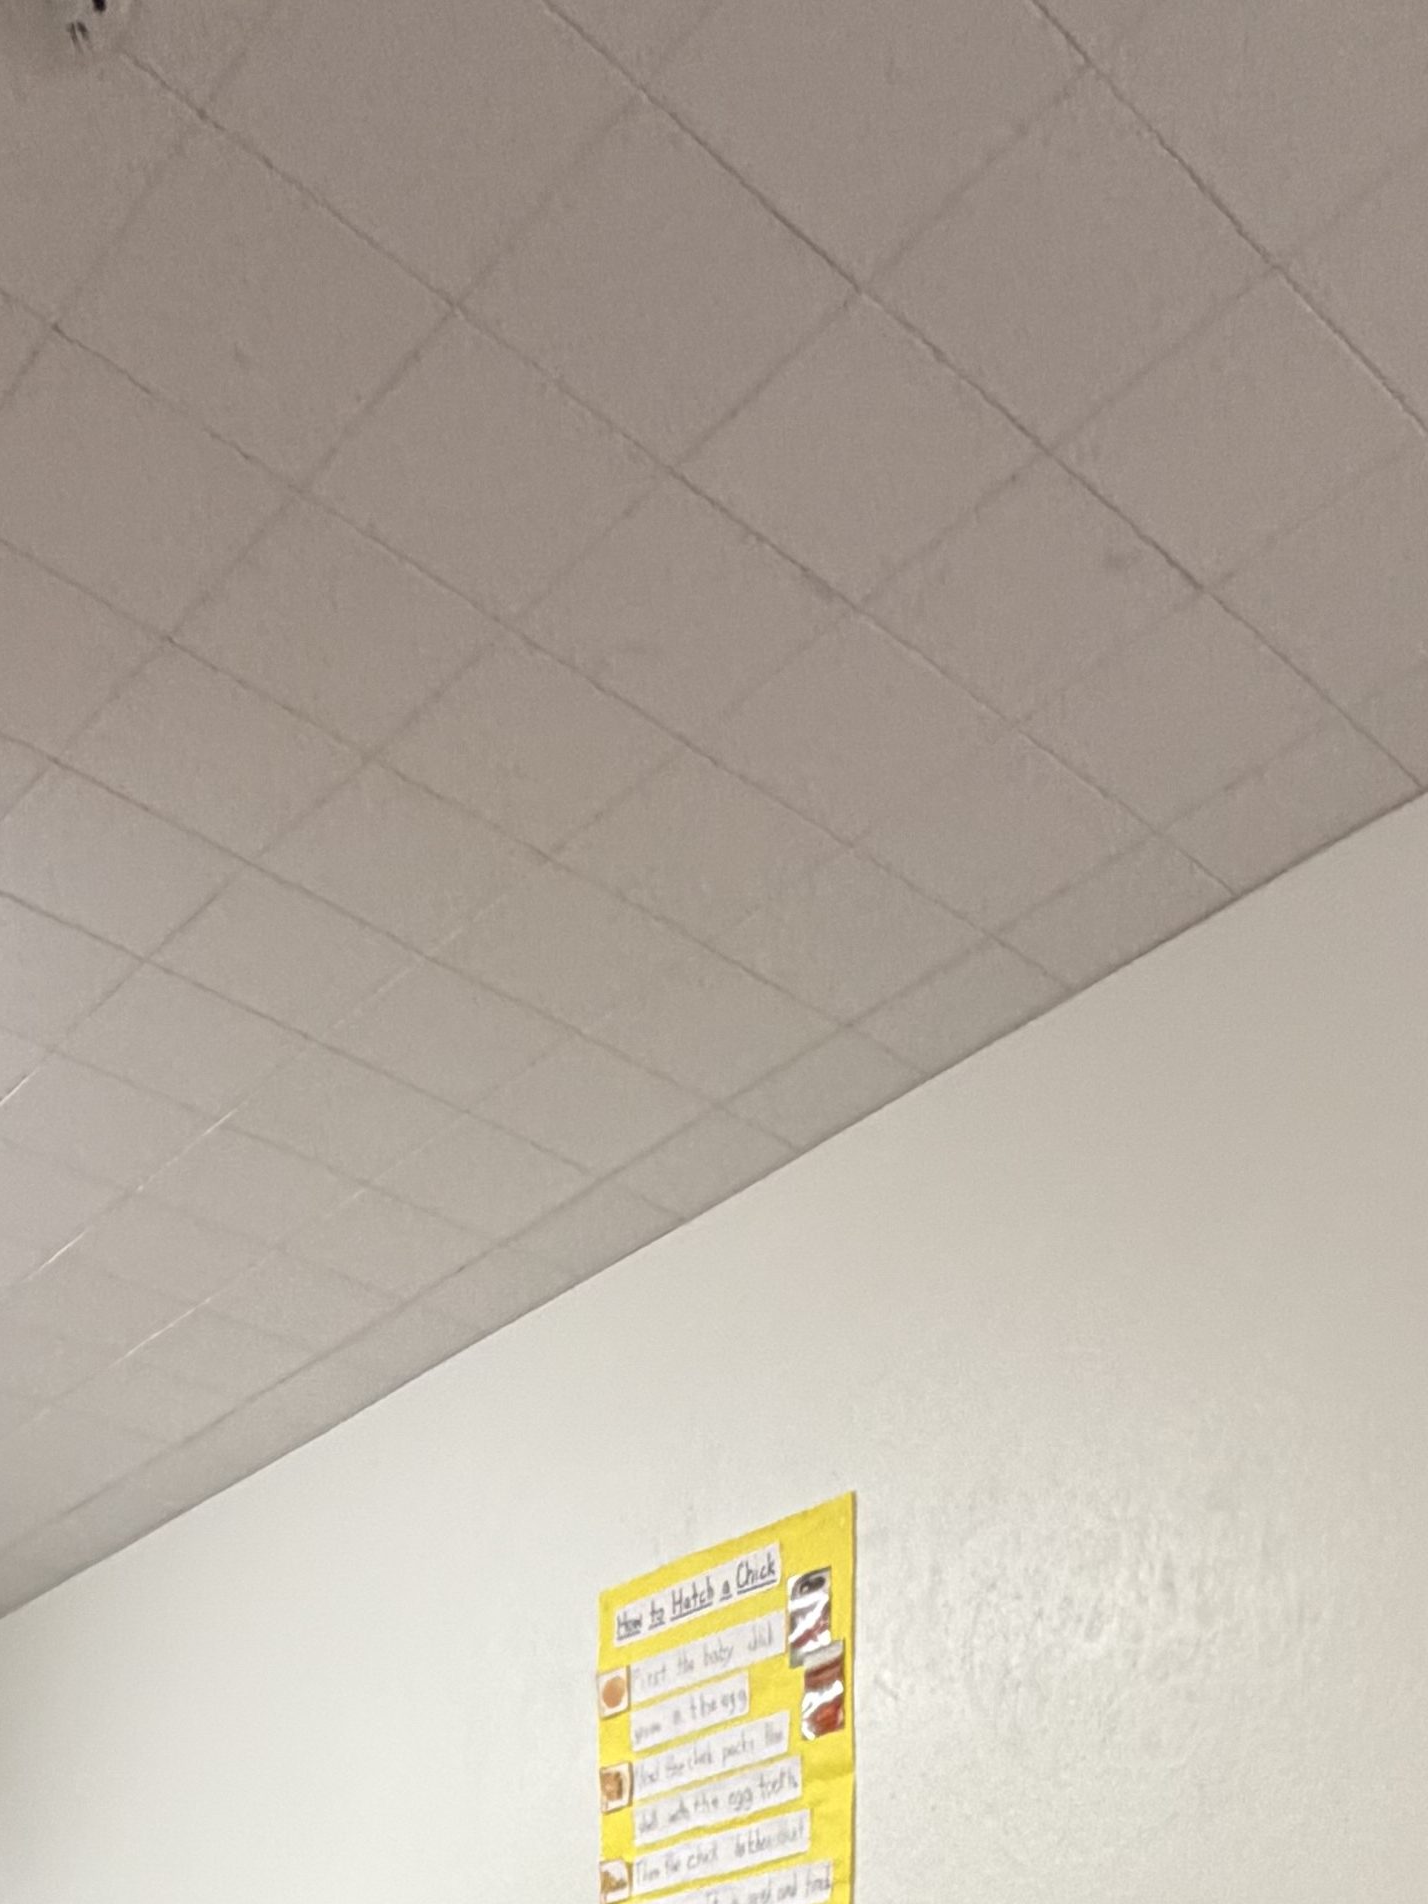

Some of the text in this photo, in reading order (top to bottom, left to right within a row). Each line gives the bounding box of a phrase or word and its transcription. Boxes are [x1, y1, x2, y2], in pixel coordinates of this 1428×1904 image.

[616, 1609, 643, 1637] How
[650, 1600, 664, 1624] to
[671, 1575, 715, 1616] Hatch
[736, 1552, 776, 1589] Chick
